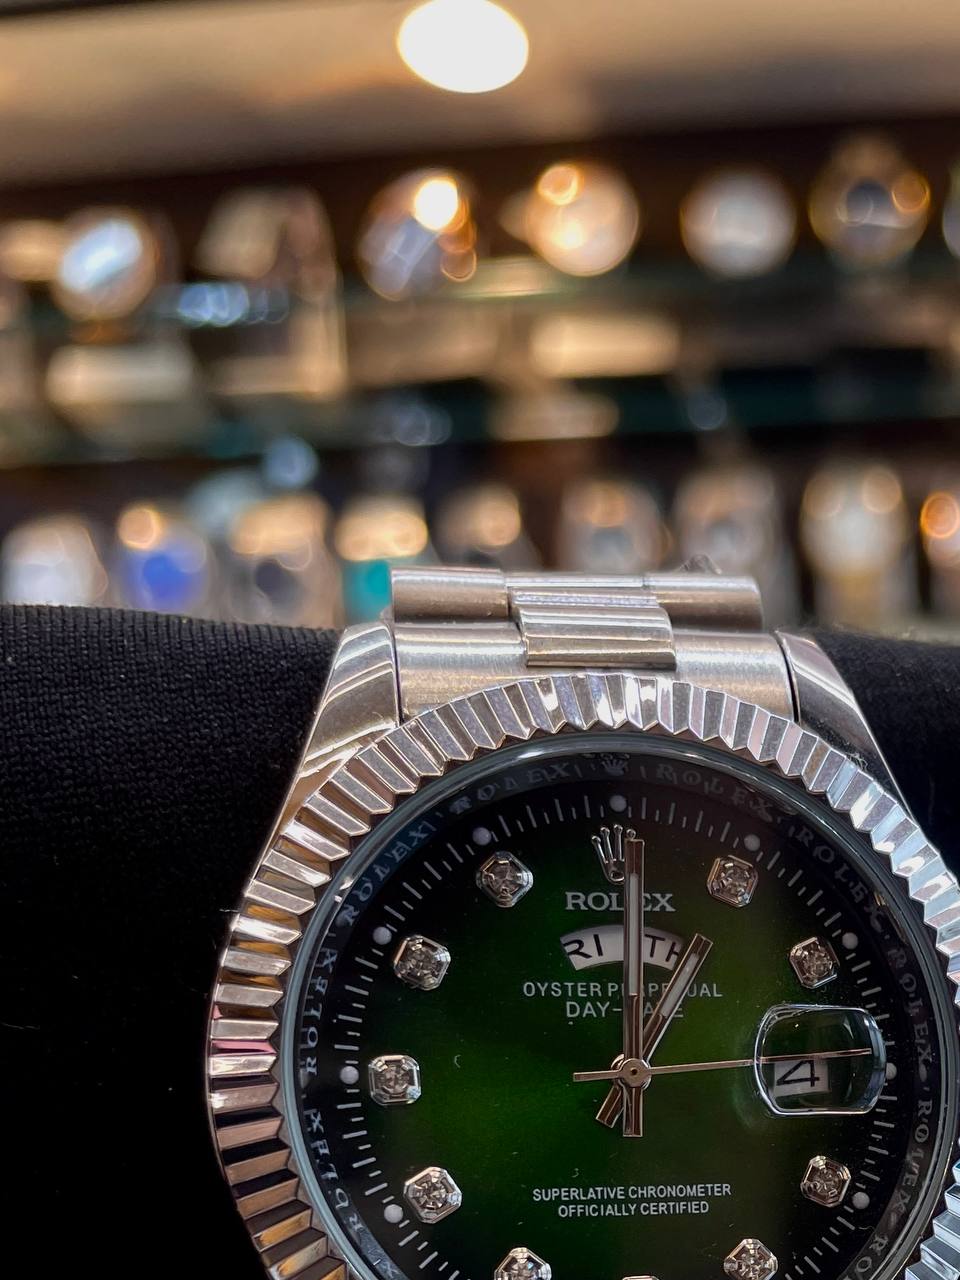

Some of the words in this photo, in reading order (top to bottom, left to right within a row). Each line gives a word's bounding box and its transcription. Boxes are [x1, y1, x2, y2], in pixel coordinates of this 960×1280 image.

[523, 982, 602, 997] OYSTER
[533, 1186, 625, 1201] SUPERLATIVE
[628, 1184, 732, 1198] CHRONOMETER
[558, 1203, 637, 1217] OFFICIALLY
[640, 1201, 709, 1215] CERTIFIED
